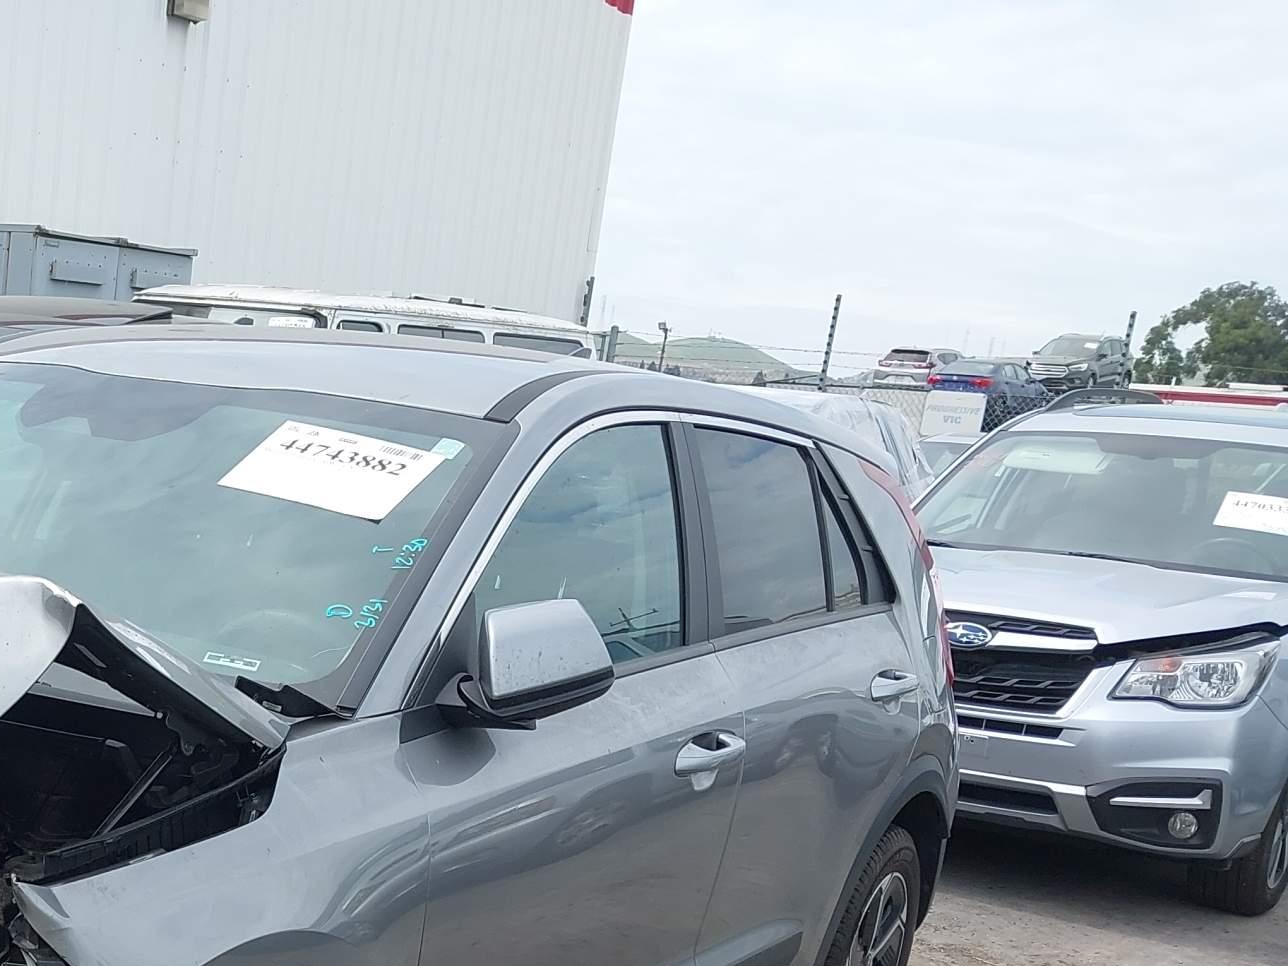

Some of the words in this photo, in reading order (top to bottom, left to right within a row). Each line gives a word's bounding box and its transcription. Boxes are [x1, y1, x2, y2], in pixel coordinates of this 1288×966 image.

[943, 415, 961, 424] VIC
[280, 438, 407, 476] 44743882
[391, 538, 428, 569] 12:30
